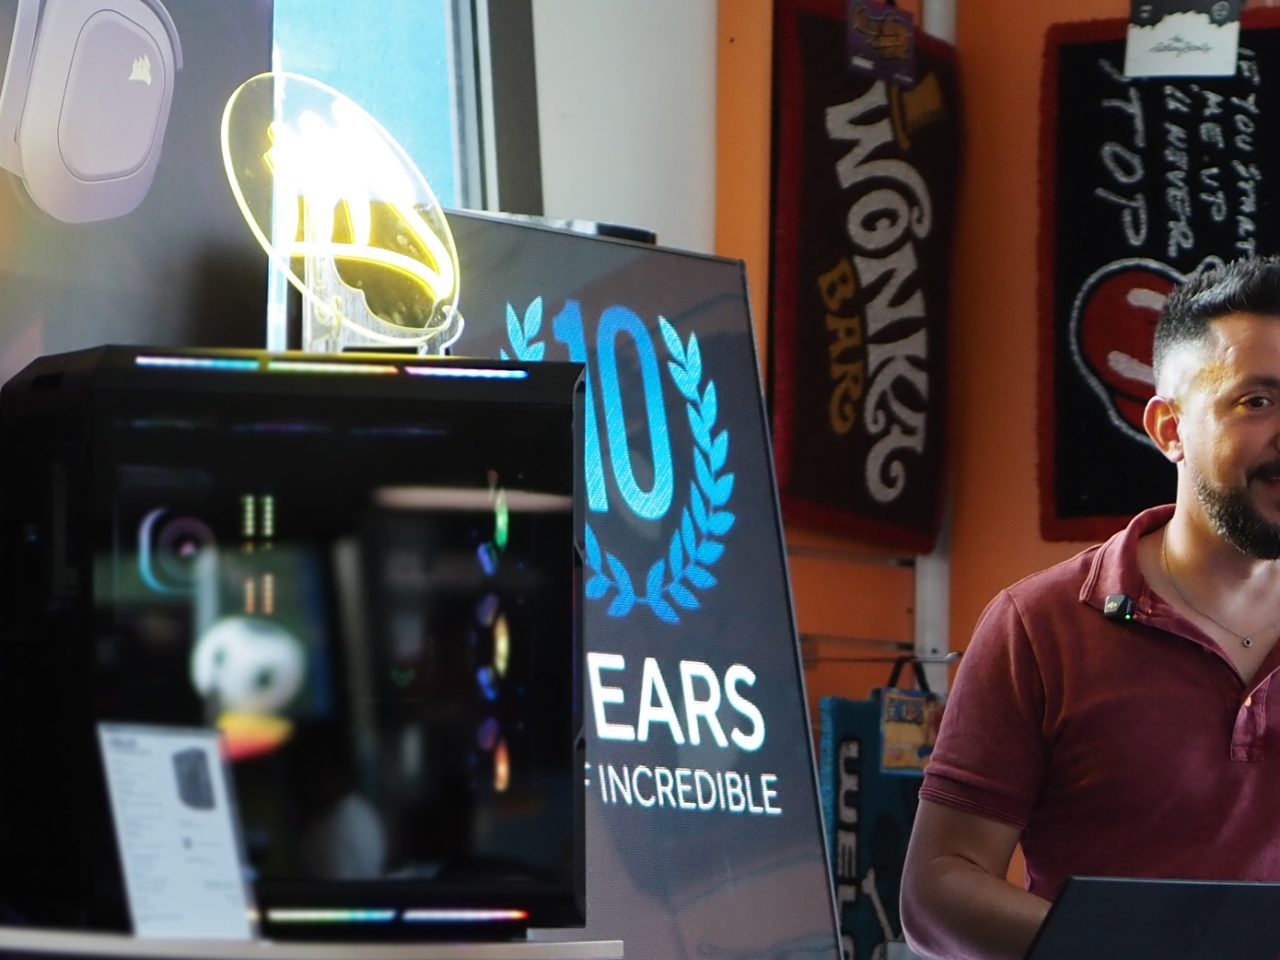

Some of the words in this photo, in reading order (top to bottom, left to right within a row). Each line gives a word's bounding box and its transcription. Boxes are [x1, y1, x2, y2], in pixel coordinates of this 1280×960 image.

[1199, 89, 1225, 149] ME
[1230, 92, 1263, 152] YOU
[1163, 121, 1196, 258] NEVER
[1199, 166, 1227, 223] UP
[1230, 159, 1263, 258] START
[824, 80, 933, 504] WONKA
[816, 256, 864, 435] BAR
[552, 300, 673, 520] 10
[597, 763, 783, 816] INCREDIBLE
